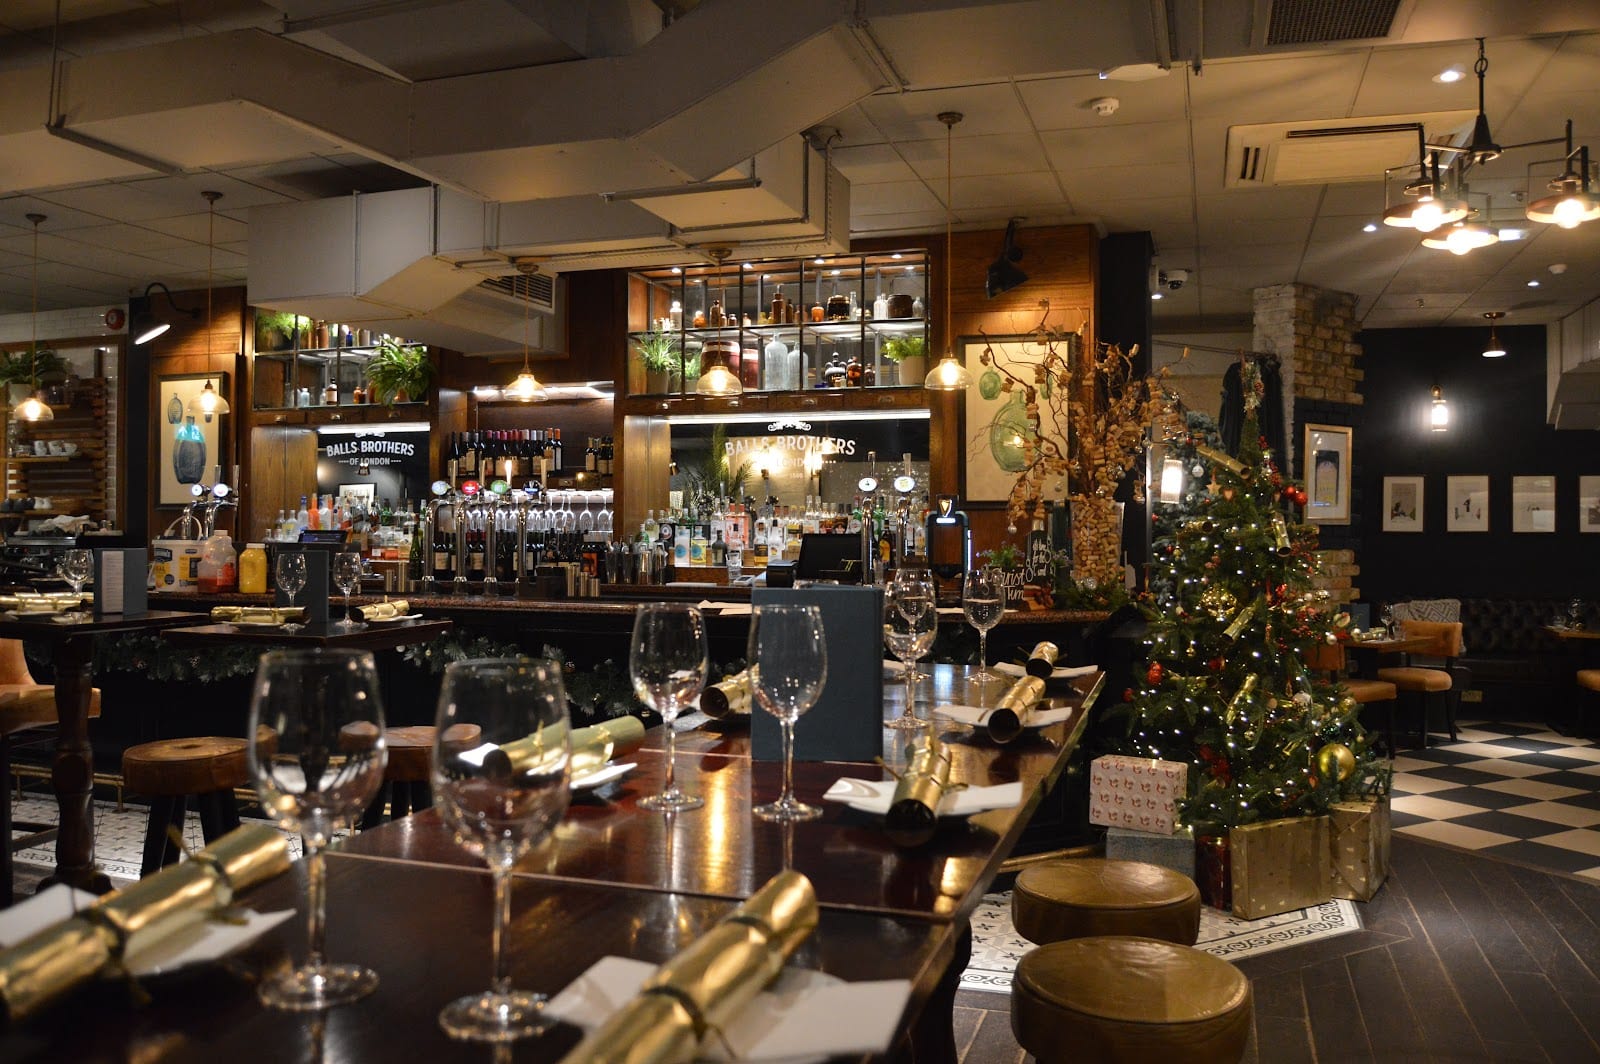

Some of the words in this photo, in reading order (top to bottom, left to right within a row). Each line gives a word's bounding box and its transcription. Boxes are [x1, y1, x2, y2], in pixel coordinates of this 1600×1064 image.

[326, 441, 357, 457] BALLS
[360, 440, 415, 456] BROTHERS
[349, 457, 359, 466] OF
[360, 457, 391, 466] LONDON
[1004, 585, 1025, 600] Tim
